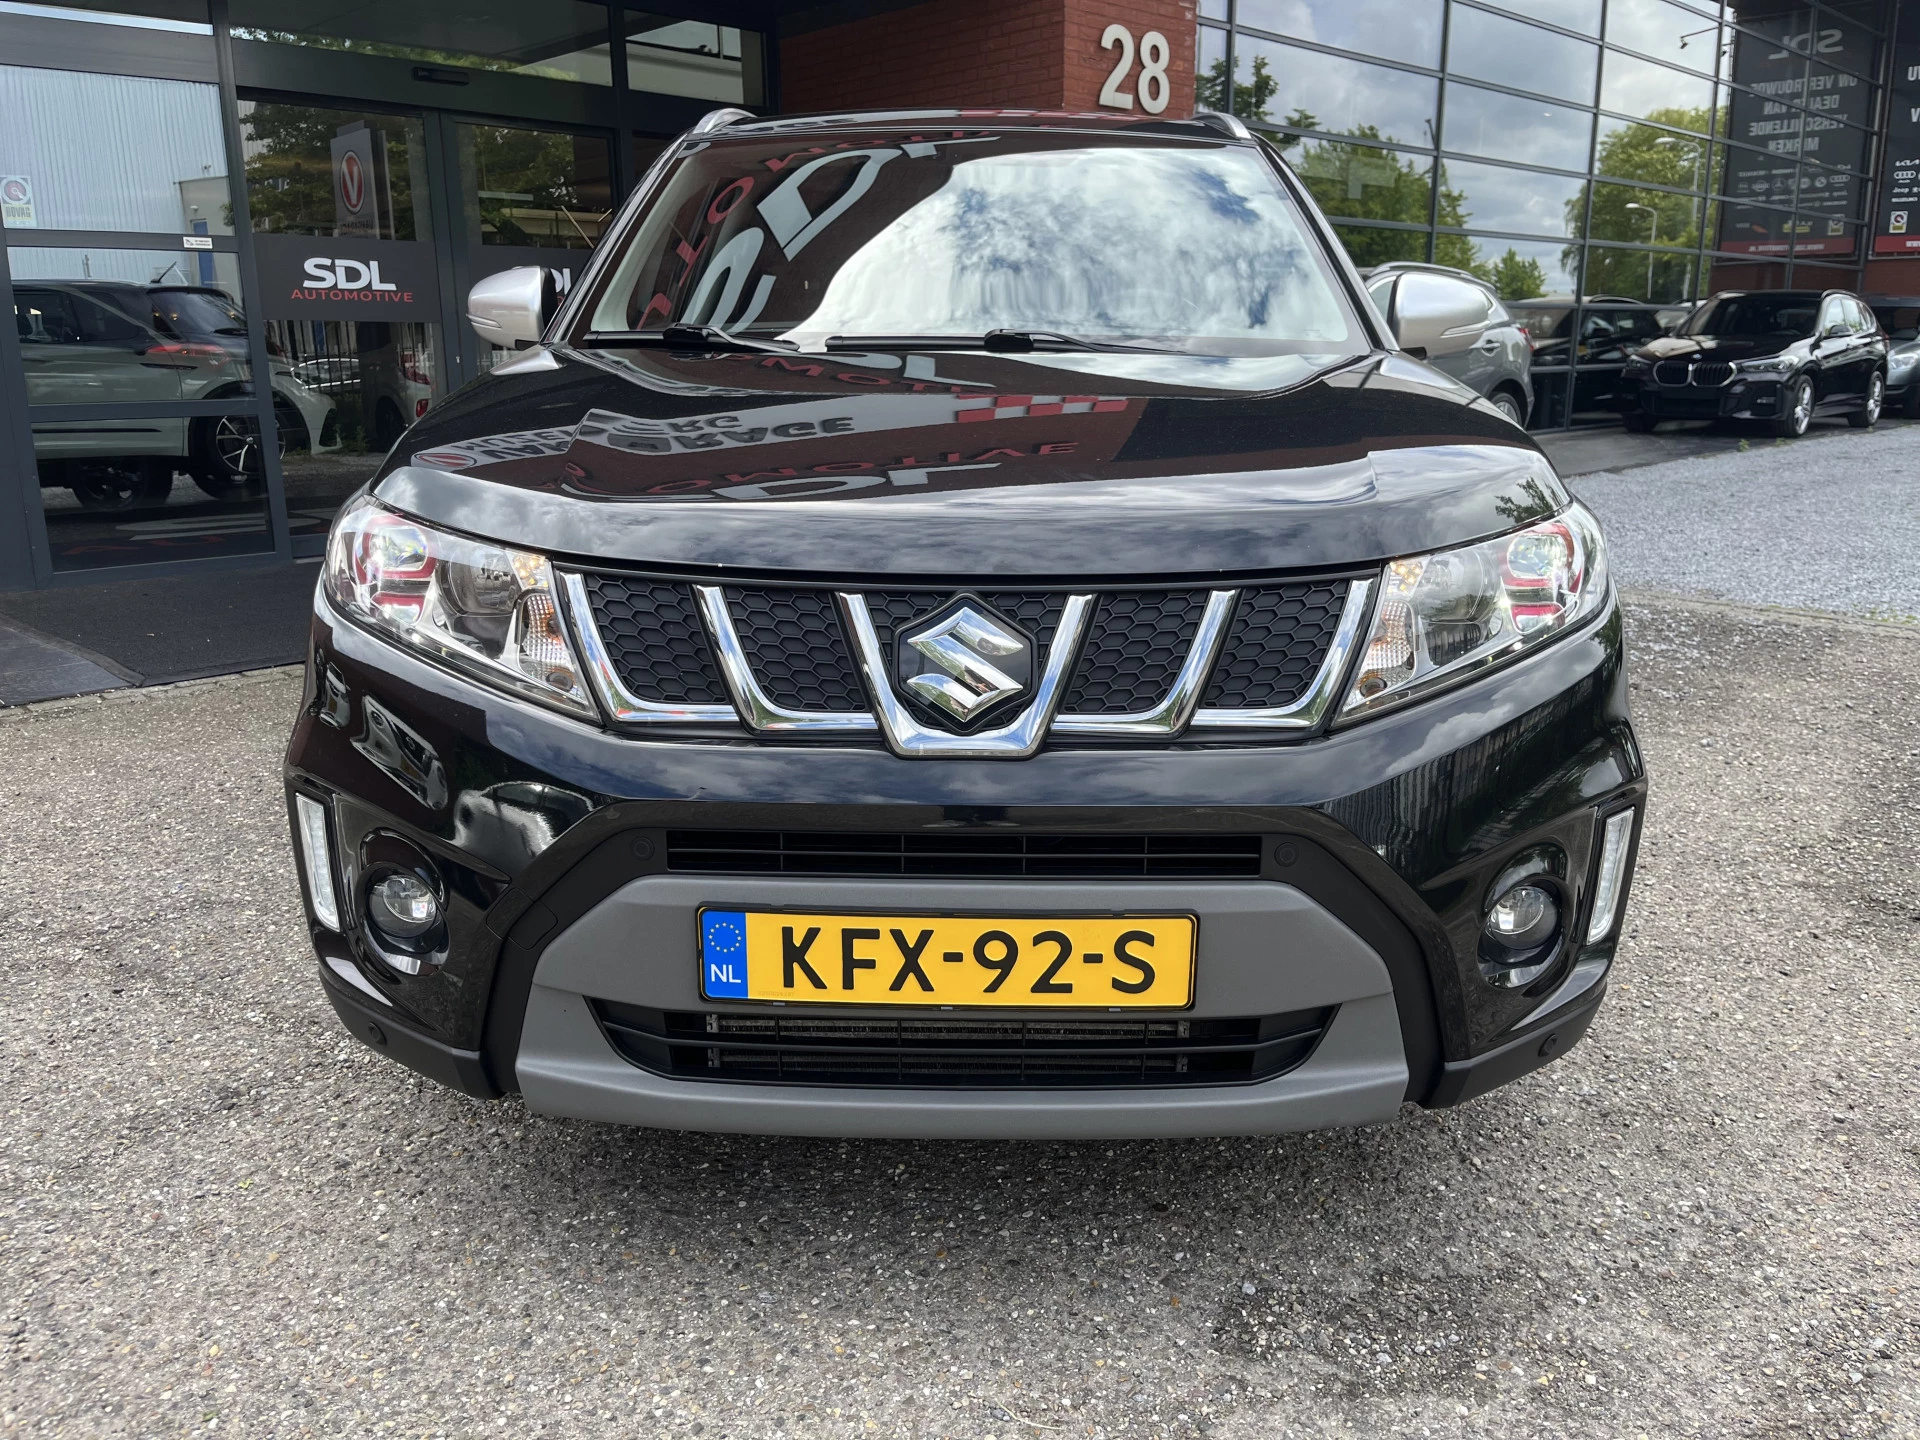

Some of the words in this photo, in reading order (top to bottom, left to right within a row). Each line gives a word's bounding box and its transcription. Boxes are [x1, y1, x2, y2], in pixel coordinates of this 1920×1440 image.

[1098, 23, 1171, 113] 28
[302, 257, 397, 291] SDL
[291, 288, 414, 303] AUTOMOTIVE
[710, 963, 742, 984] NL
[780, 926, 1157, 995] KFX-92-S
